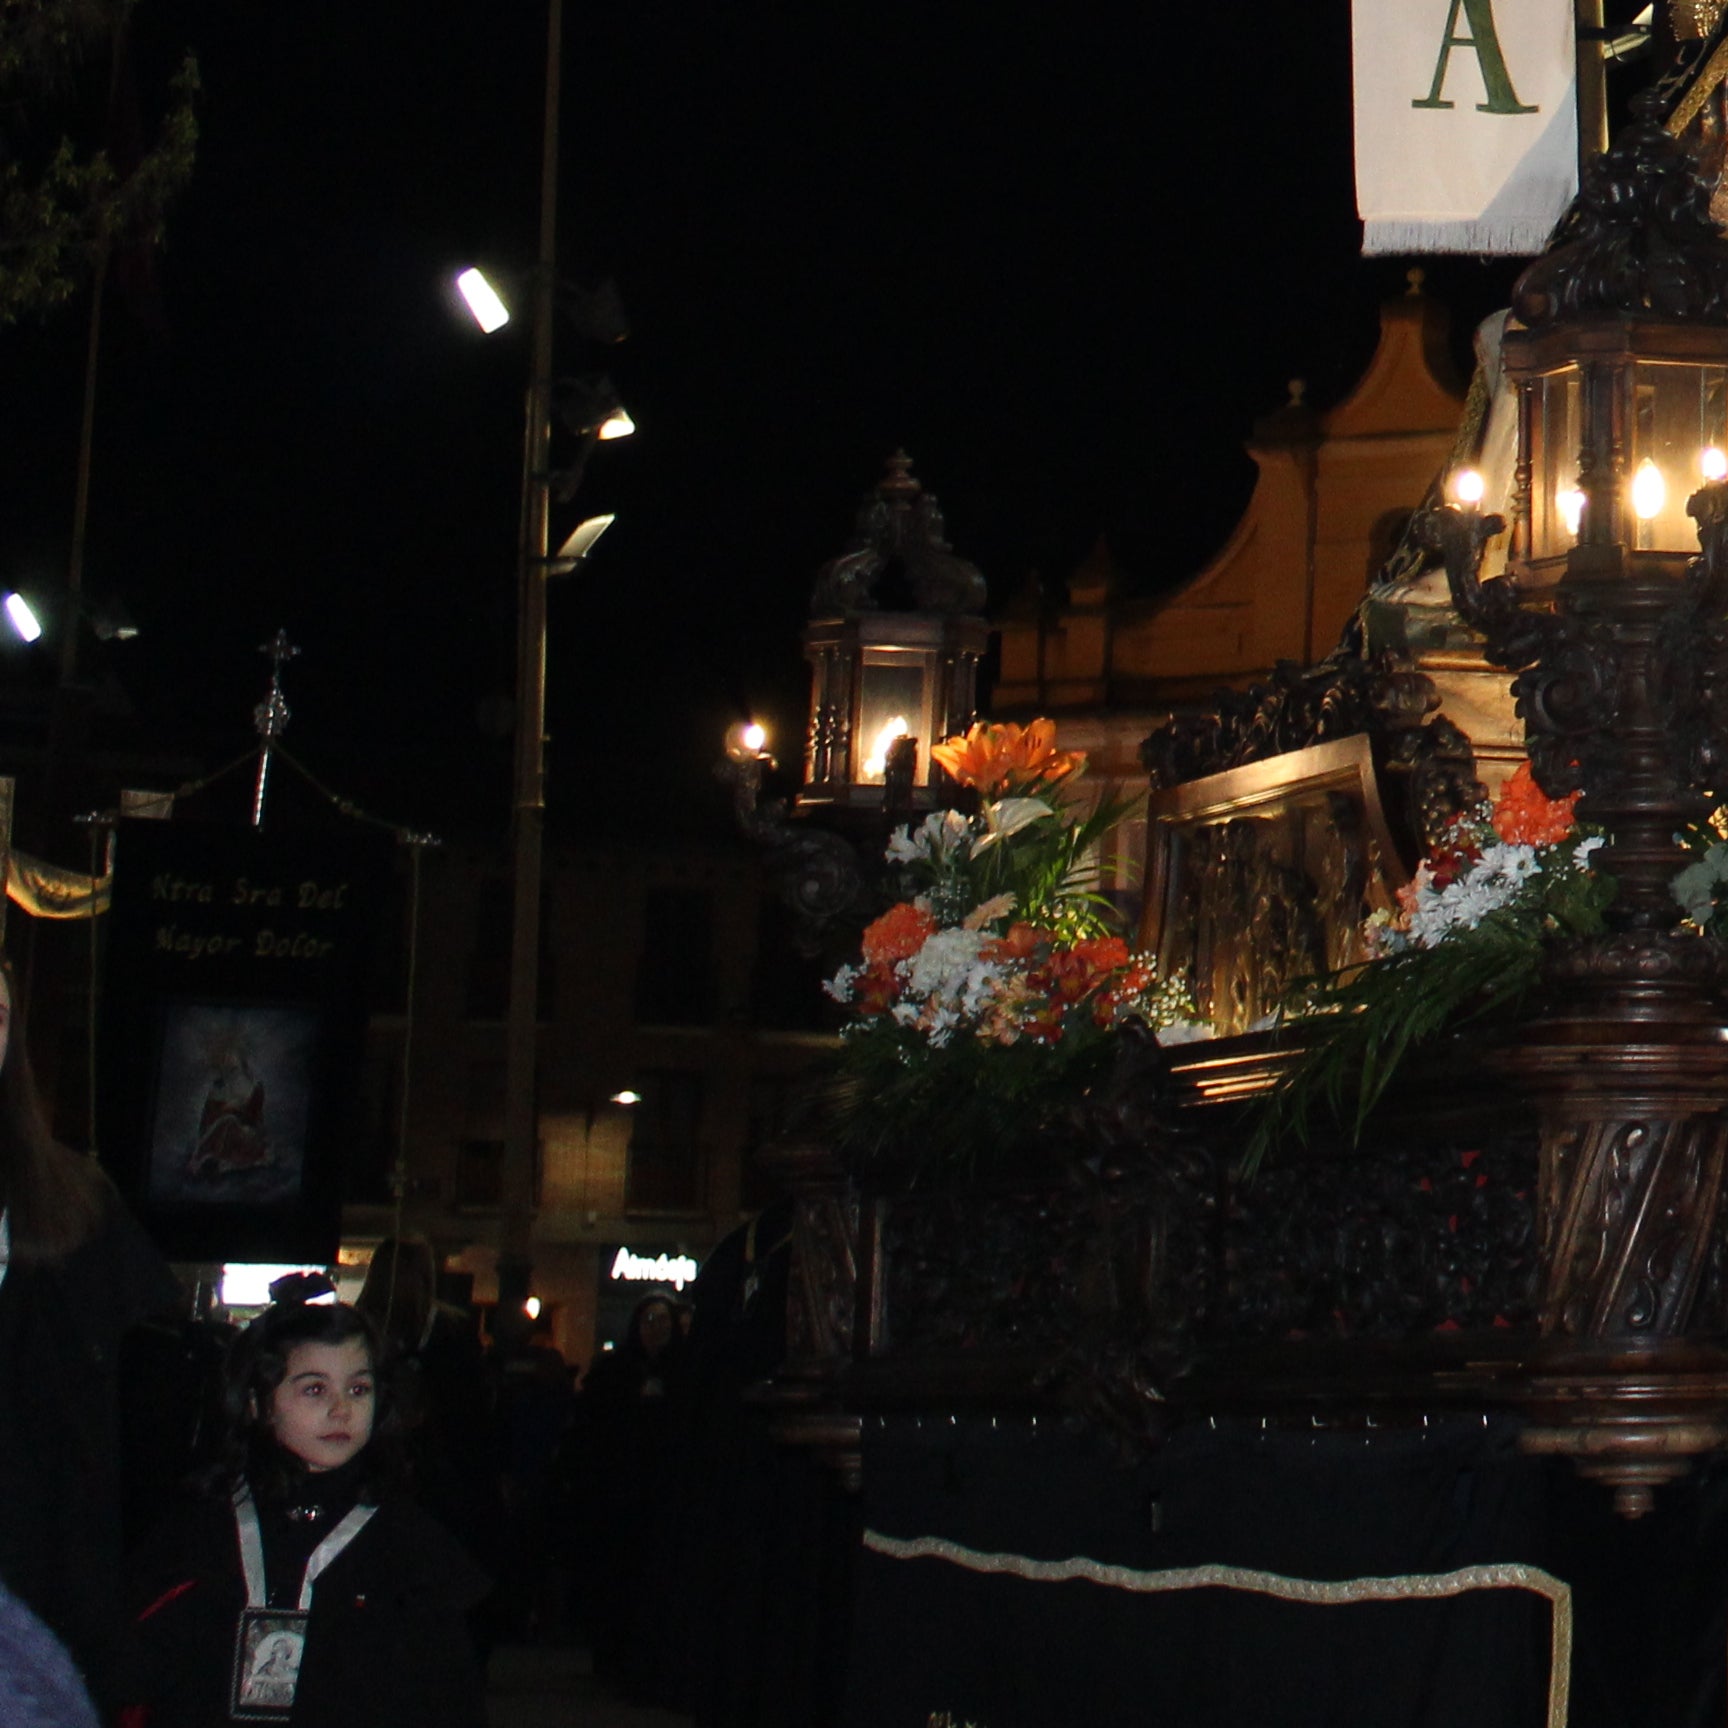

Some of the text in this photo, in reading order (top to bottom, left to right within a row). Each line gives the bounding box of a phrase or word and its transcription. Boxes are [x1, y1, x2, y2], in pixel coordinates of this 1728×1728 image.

[233, 877, 283, 908] Sra
[298, 881, 350, 911] Del
[152, 922, 336, 960] Mayor Dolor
